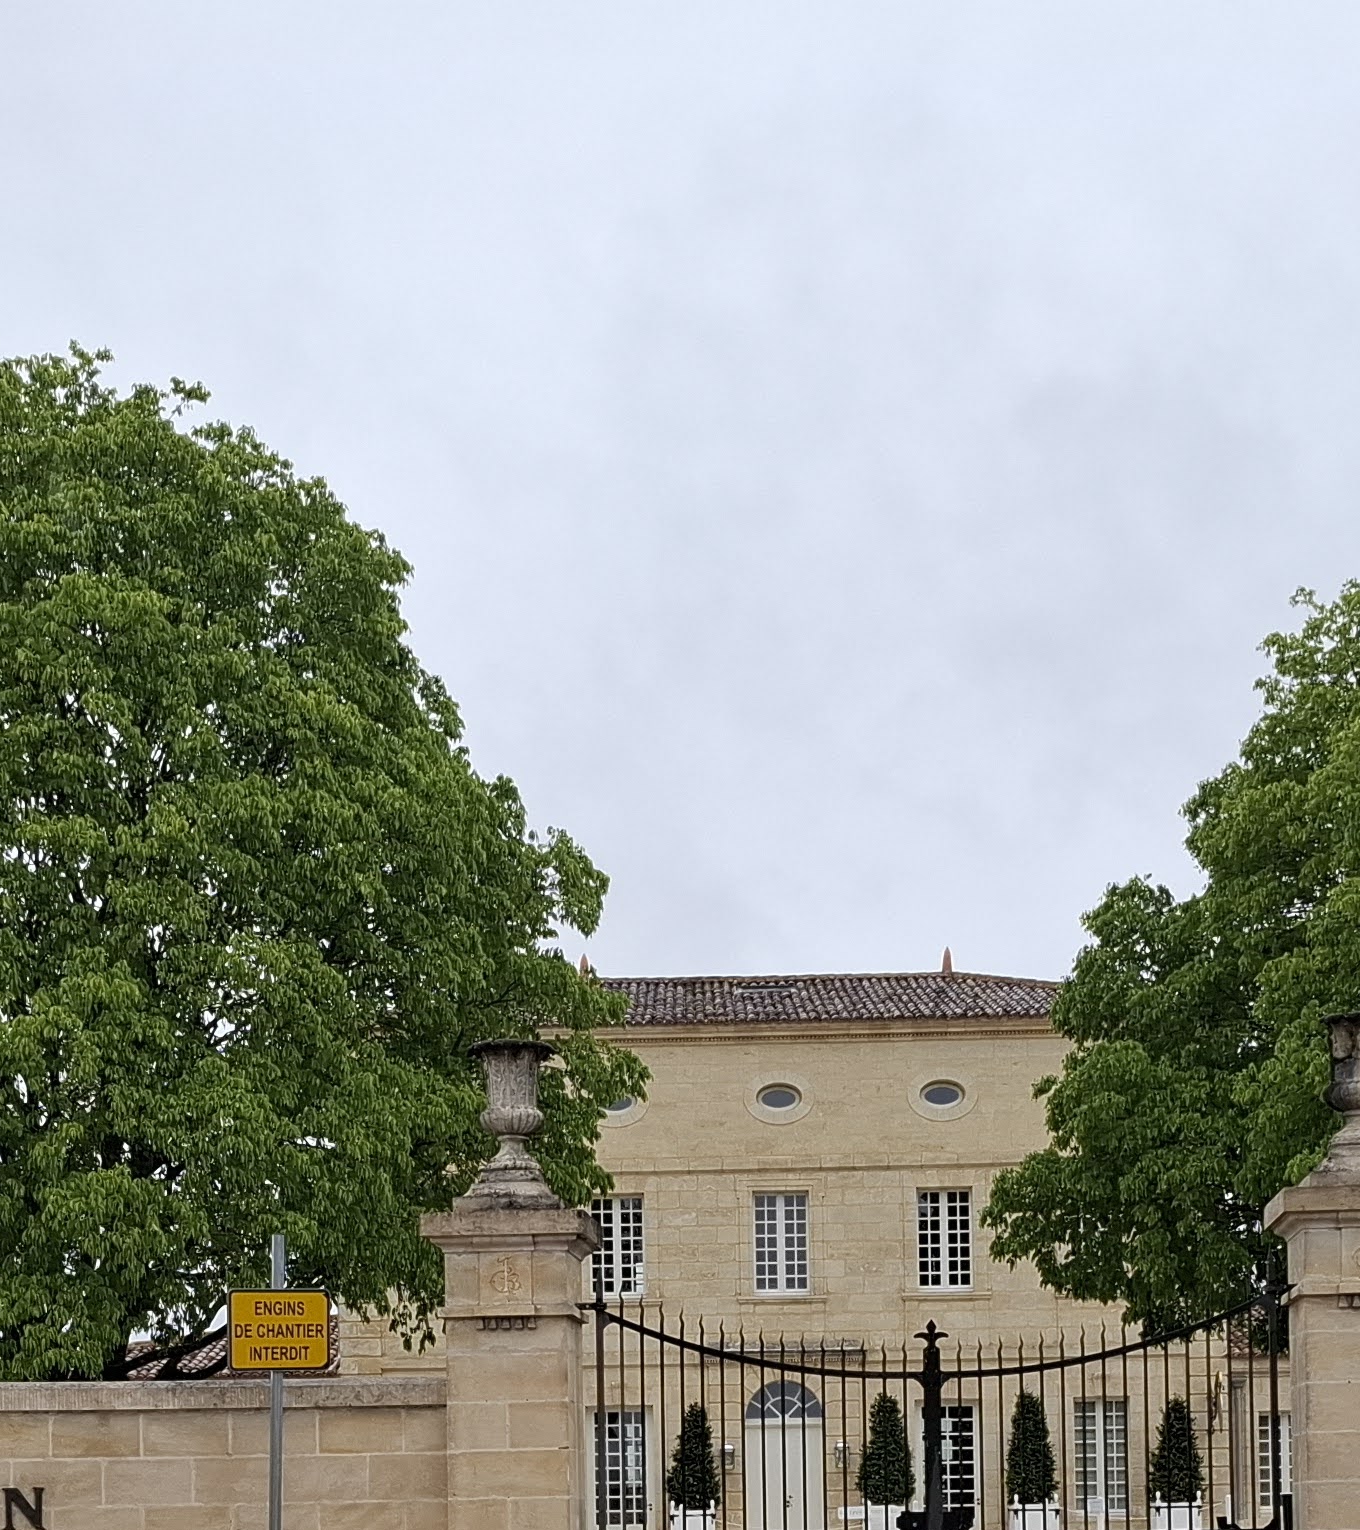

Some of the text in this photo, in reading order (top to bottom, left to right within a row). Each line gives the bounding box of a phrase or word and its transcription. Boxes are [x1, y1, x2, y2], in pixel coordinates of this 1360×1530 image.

[254, 1300, 305, 1316] ENGINS
[235, 1323, 324, 1338] DE CHANTIER
[249, 1346, 310, 1361] INTERDIT
